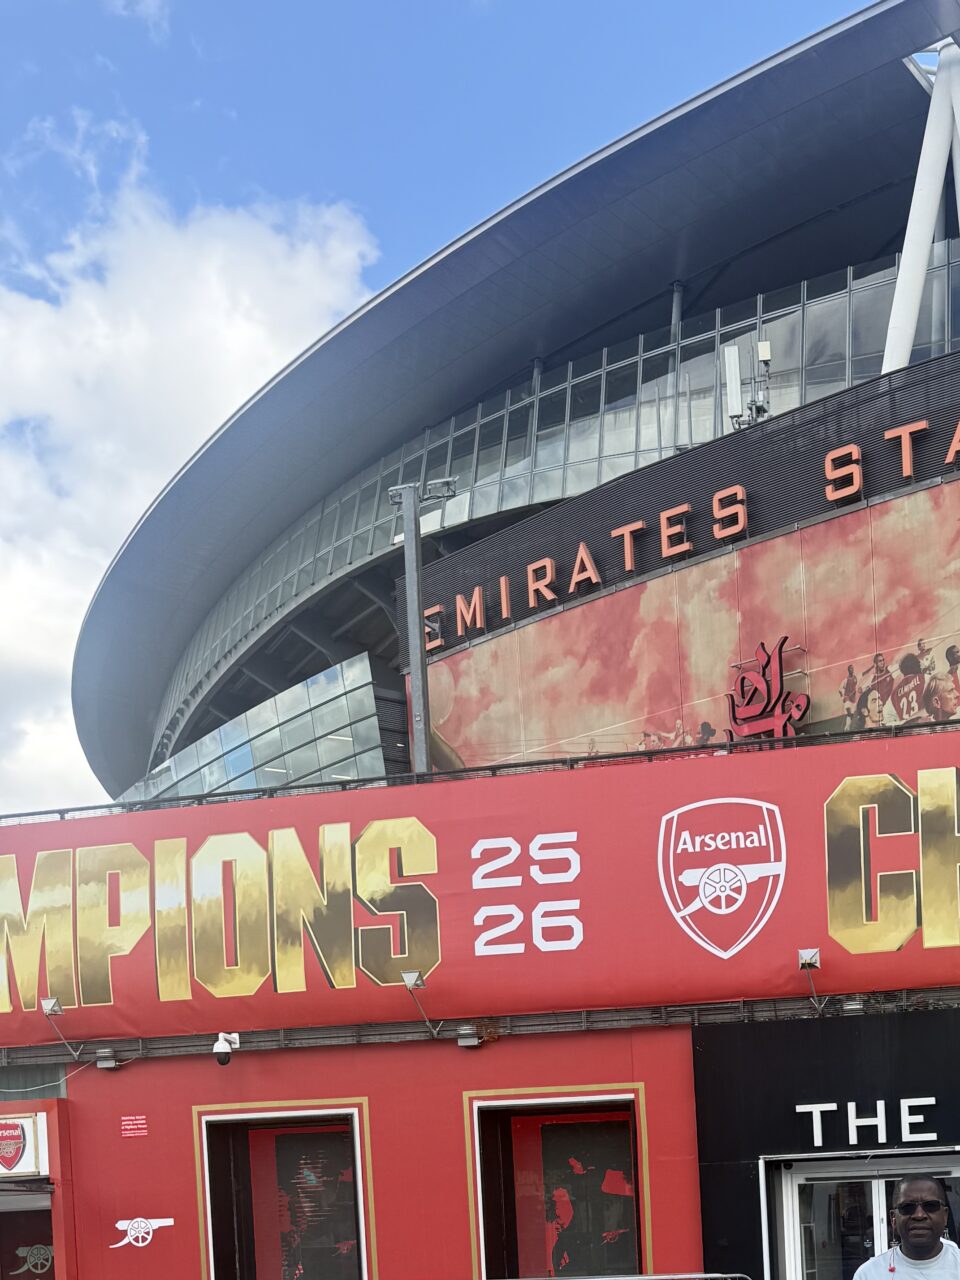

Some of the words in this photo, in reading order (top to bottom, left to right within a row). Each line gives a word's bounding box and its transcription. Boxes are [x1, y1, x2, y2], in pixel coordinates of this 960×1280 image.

[424, 484, 748, 653] EMIRATES
[900, 690, 919, 719] 23
[471, 831, 582, 890] 25
[676, 824, 770, 854] Arsenal
[474, 899, 584, 956] 26
[0, 1128, 22, 1137] rsenal
[796, 1097, 939, 1147] THE
